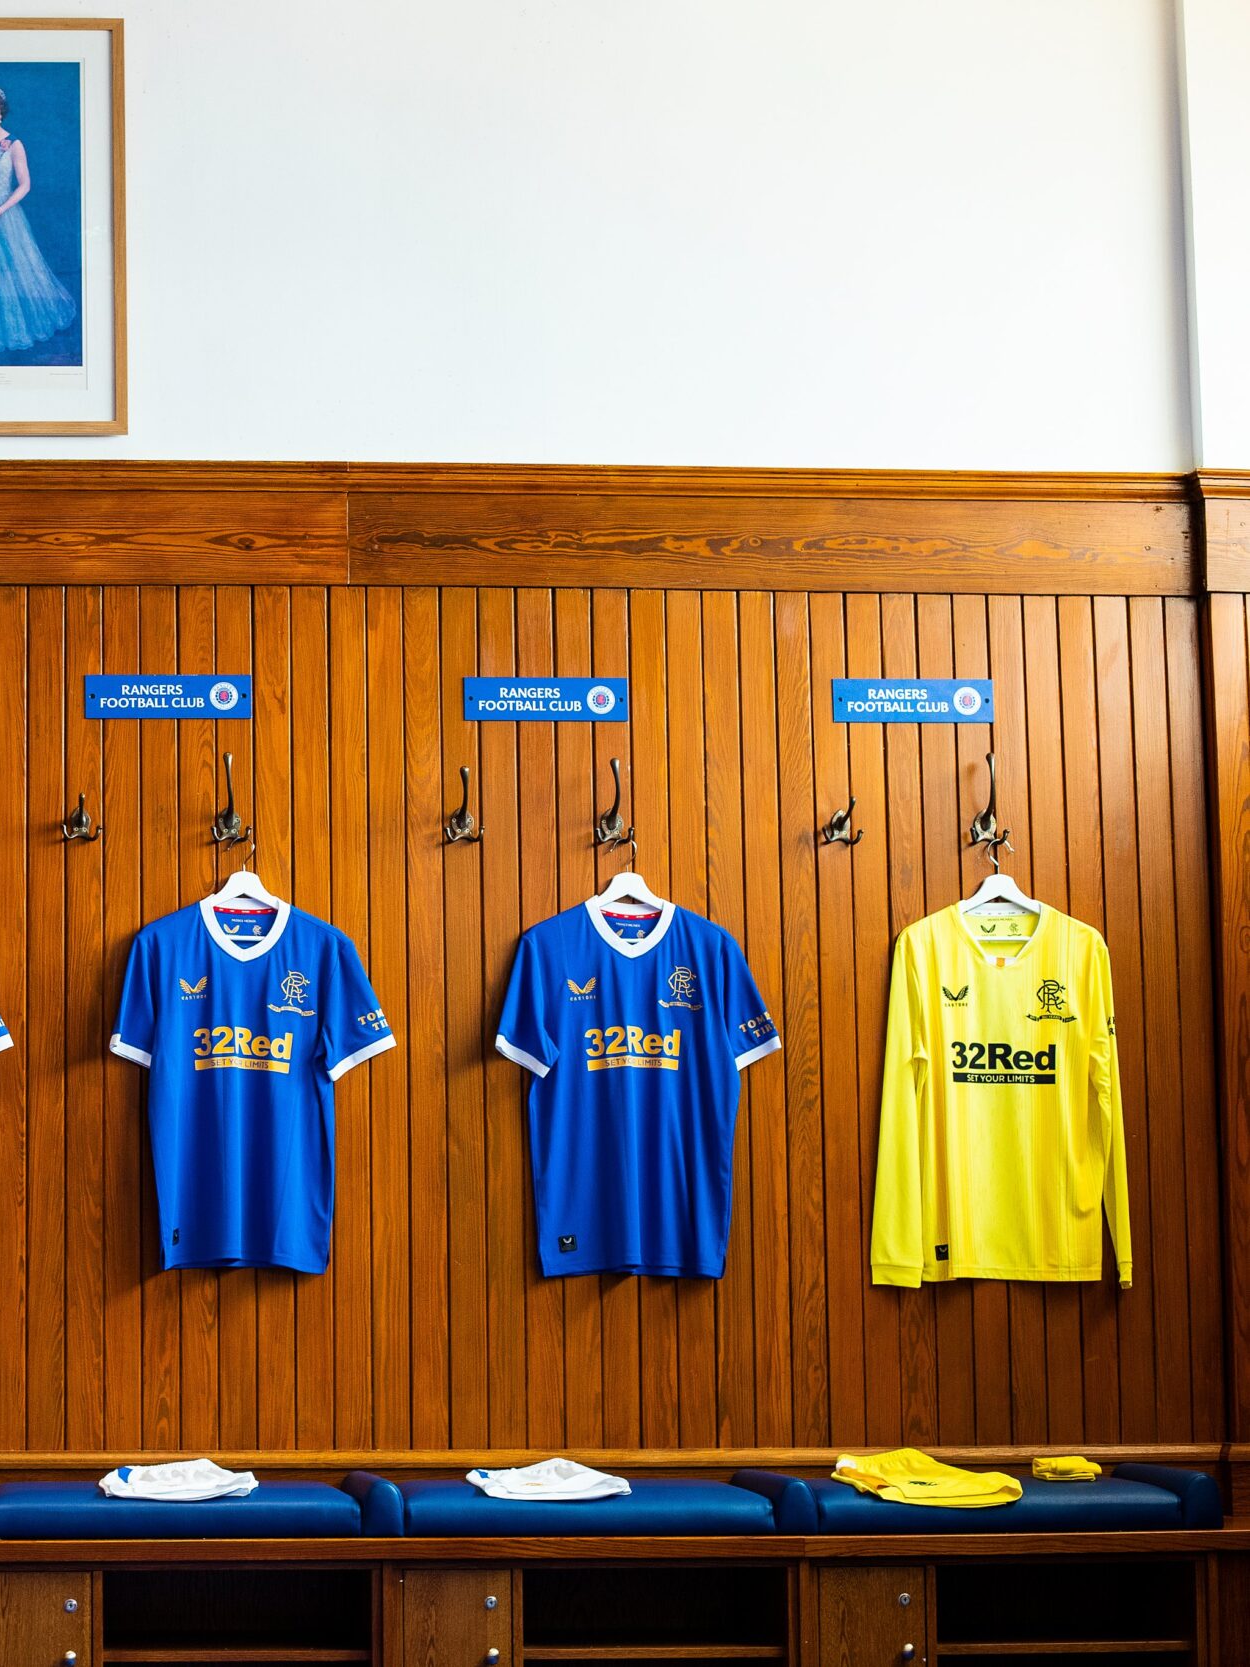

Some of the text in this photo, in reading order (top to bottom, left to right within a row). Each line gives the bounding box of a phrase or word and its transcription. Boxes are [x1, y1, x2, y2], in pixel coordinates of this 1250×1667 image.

[121, 684, 183, 696] RANGERS
[499, 687, 561, 699] RANGERS
[867, 688, 928, 700] RANGERS
[99, 697, 205, 709] FOOTBALL CLUB
[478, 699, 582, 712] FOOTBALL CLUB
[847, 700, 915, 713] FOOTBALL
[917, 701, 949, 713] CLUB
[193, 1026, 293, 1060] 32Red
[584, 1025, 681, 1057] 32Red
[951, 1041, 1056, 1071] 32Red
[210, 1059, 226, 1067] SET
[245, 1060, 269, 1069] LIMITS
[605, 1058, 620, 1067] SET
[637, 1059, 662, 1067] LIMITS
[966, 1074, 979, 1082] SET
[1007, 1075, 1036, 1083] LIMITS
